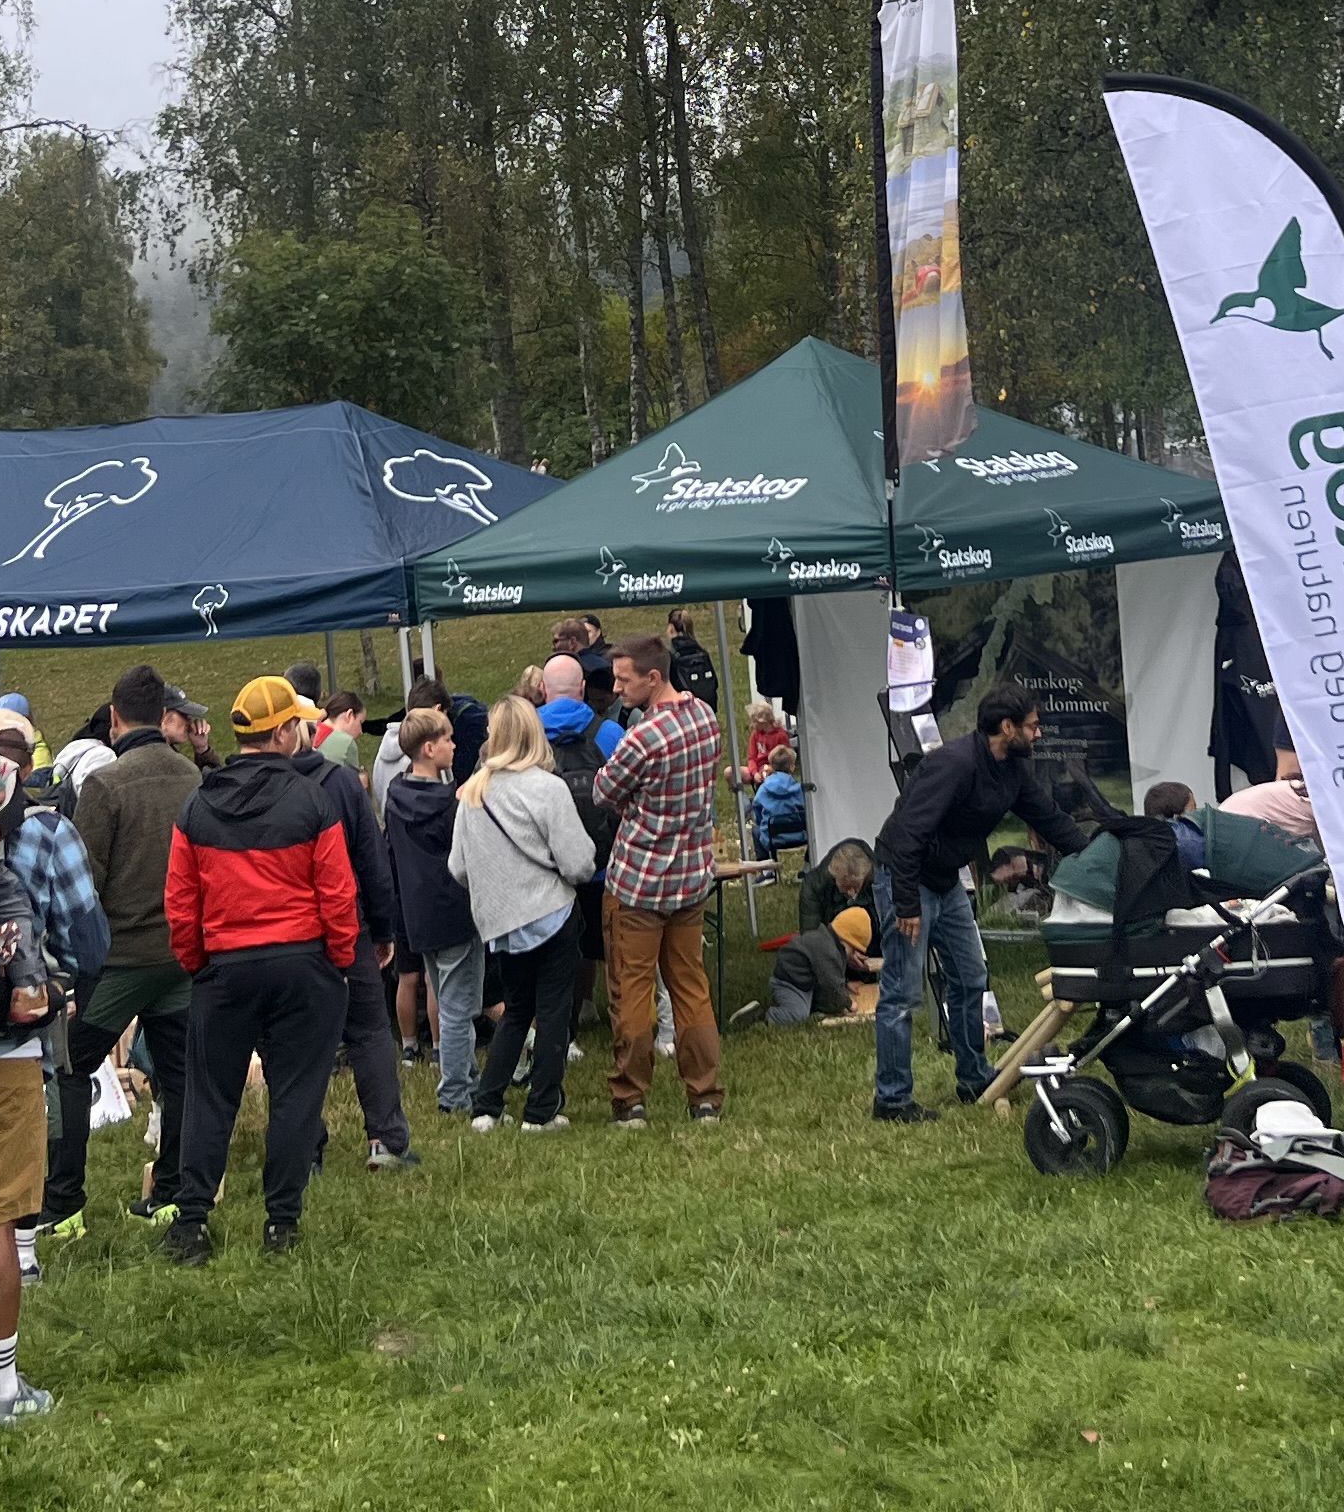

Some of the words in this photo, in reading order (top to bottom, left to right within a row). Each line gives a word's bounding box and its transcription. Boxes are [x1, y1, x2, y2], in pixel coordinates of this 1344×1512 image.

[955, 450, 1079, 477] Statskog
[663, 473, 808, 501] Statskog
[1179, 519, 1223, 539] Statskog
[1065, 531, 1115, 553] Statskog
[938, 545, 992, 568] Statskog
[788, 558, 861, 580] Statskog
[462, 581, 523, 605] Statskog
[619, 570, 684, 593] Statskog
[1045, 693, 1110, 713] dommer
